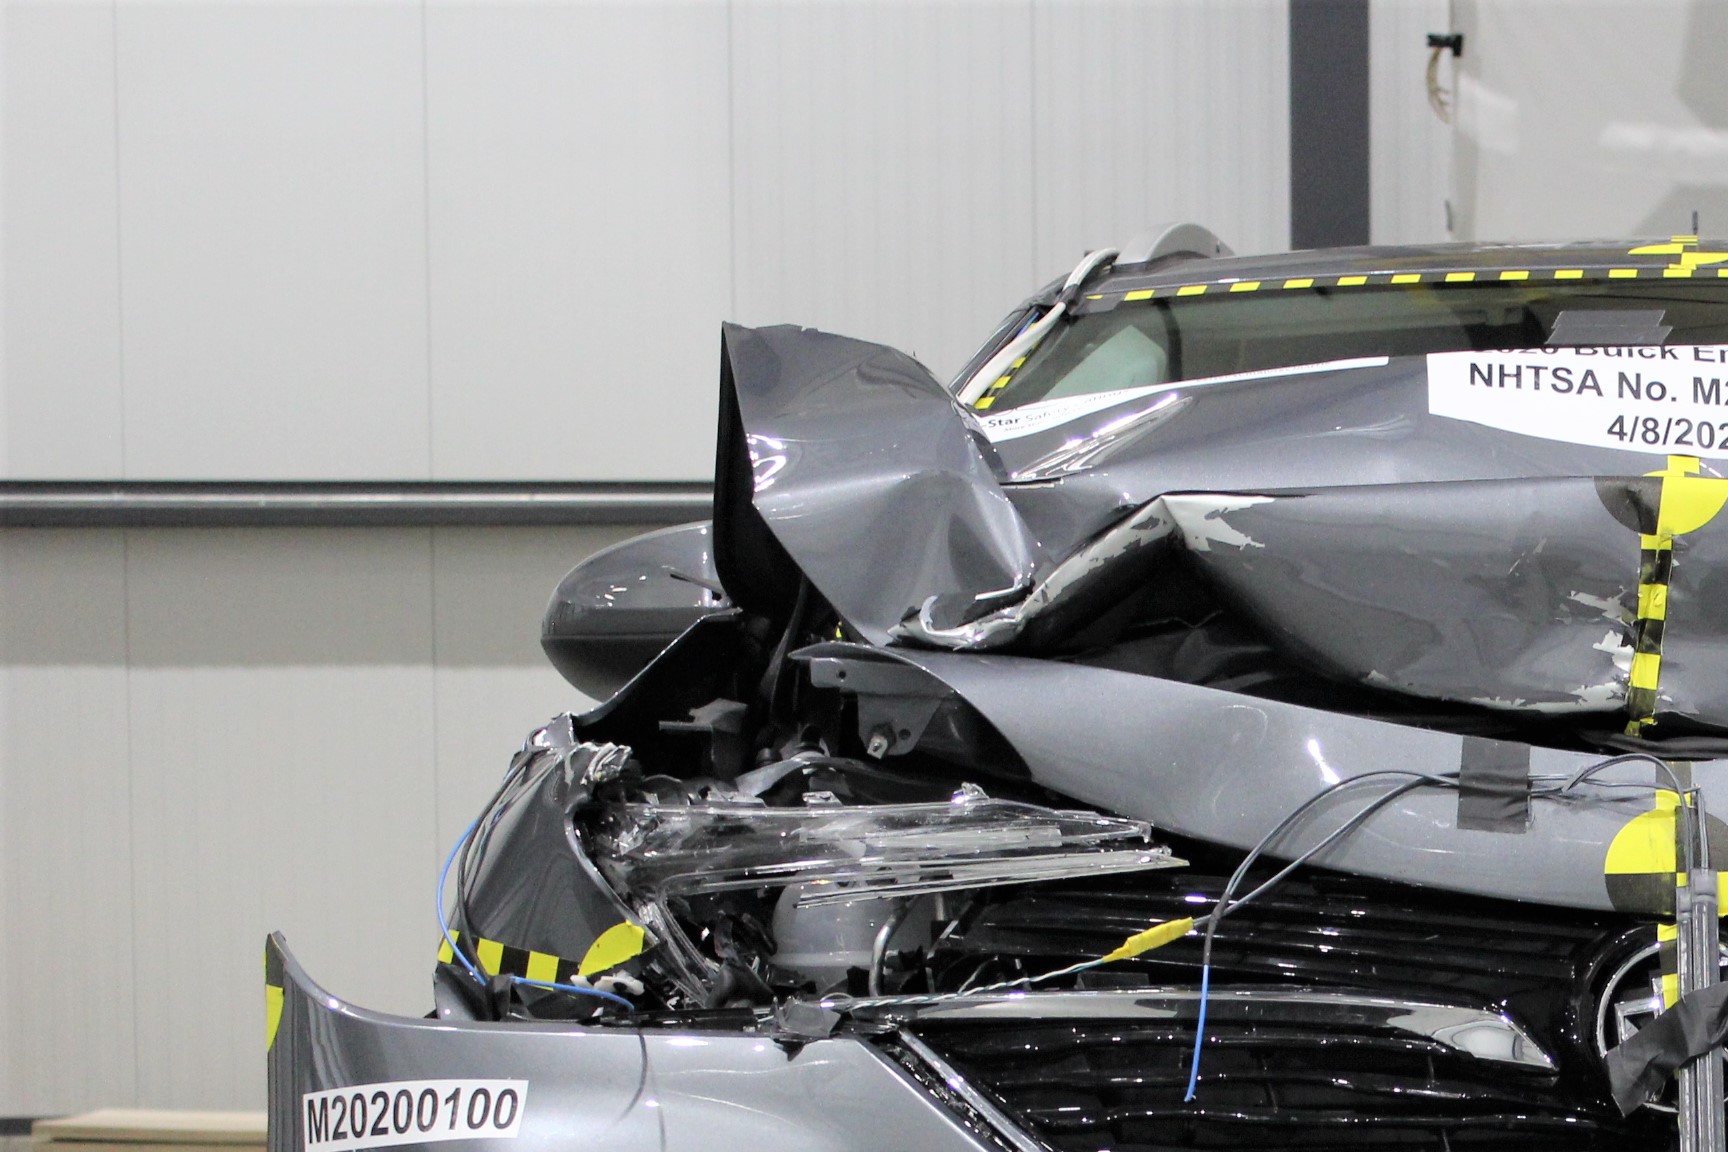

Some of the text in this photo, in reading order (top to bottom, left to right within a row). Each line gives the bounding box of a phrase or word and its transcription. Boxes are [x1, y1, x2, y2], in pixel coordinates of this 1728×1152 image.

[1469, 362, 1604, 398] NHTSA
[1617, 371, 1677, 402] No.
[980, 417, 1021, 429] -Star
[307, 1087, 519, 1145] M20200100
